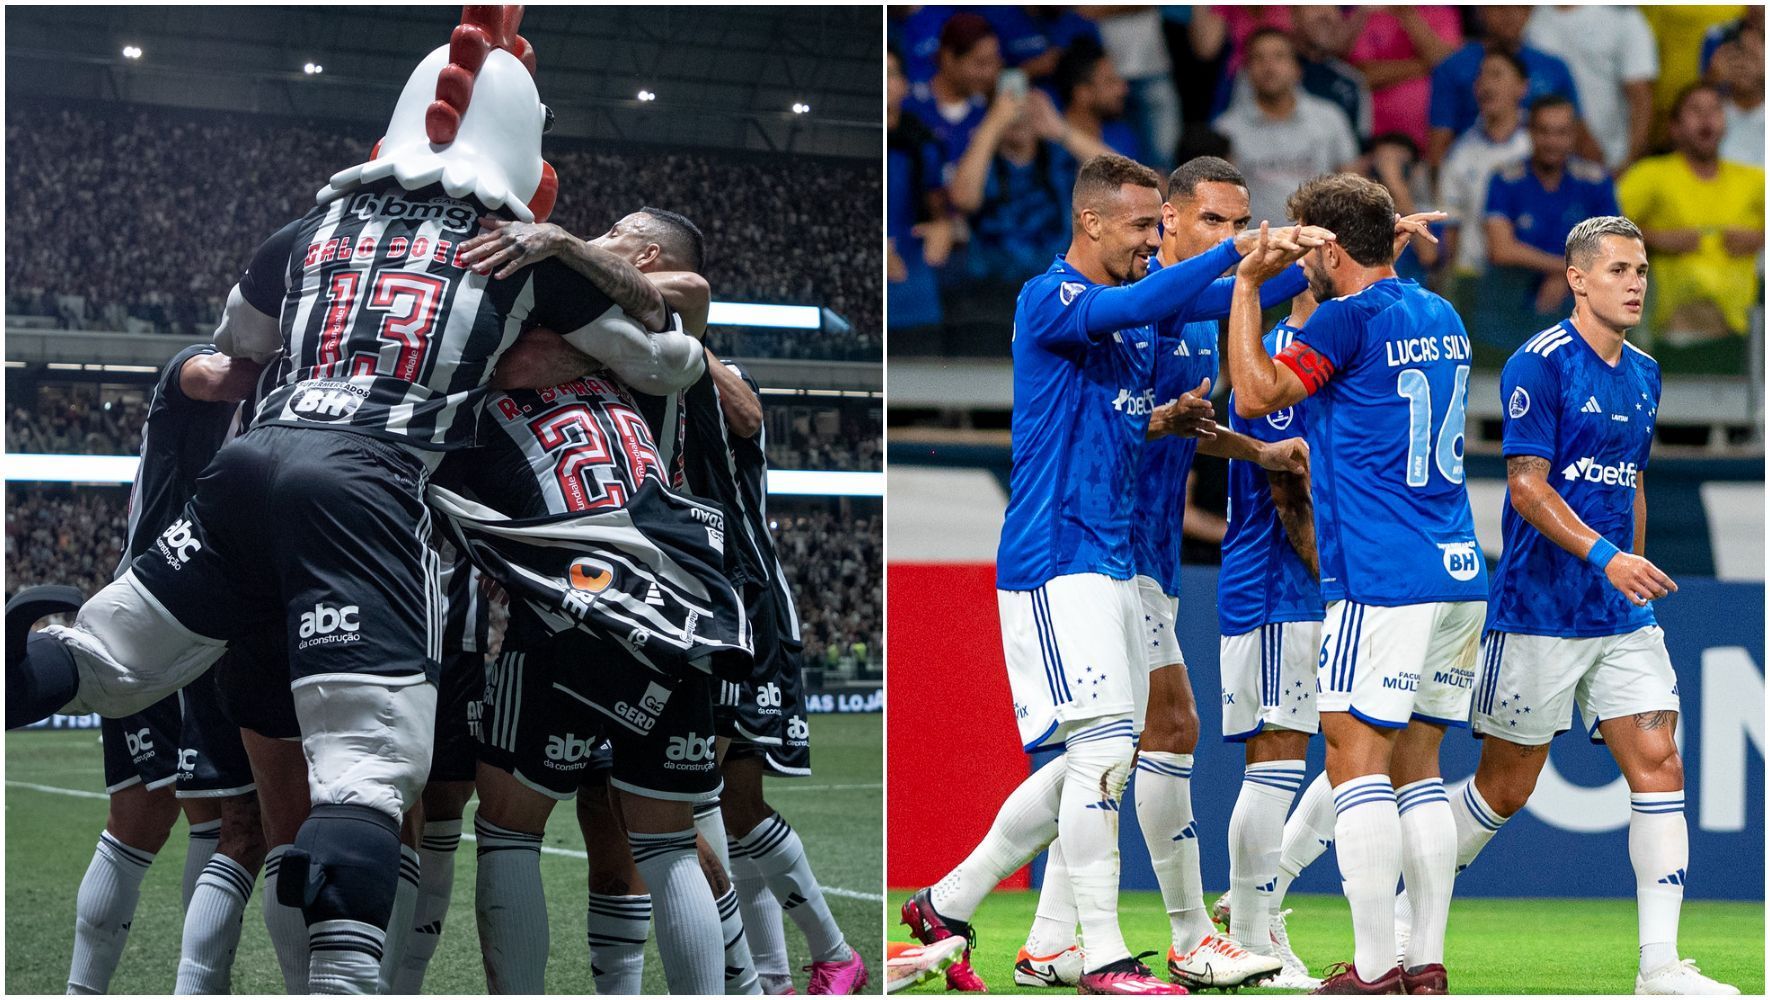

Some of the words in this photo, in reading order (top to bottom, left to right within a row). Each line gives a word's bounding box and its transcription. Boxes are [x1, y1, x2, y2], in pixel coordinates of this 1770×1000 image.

[380, 196, 472, 230] bmg
[304, 237, 377, 267] GALO
[311, 268, 450, 384] 13
[1386, 335, 1440, 367] LUCAS
[294, 388, 353, 417] BH
[497, 397, 532, 421] R.
[1397, 364, 1471, 487] 16
[163, 518, 202, 563] abc
[1450, 553, 1475, 571] BH
[299, 603, 360, 639] abc
[299, 640, 308, 650] da
[308, 632, 361, 646] construção
[1382, 676, 1420, 692] MUL
[665, 732, 716, 762] abc
[543, 759, 554, 768] da
[663, 761, 675, 769] da
